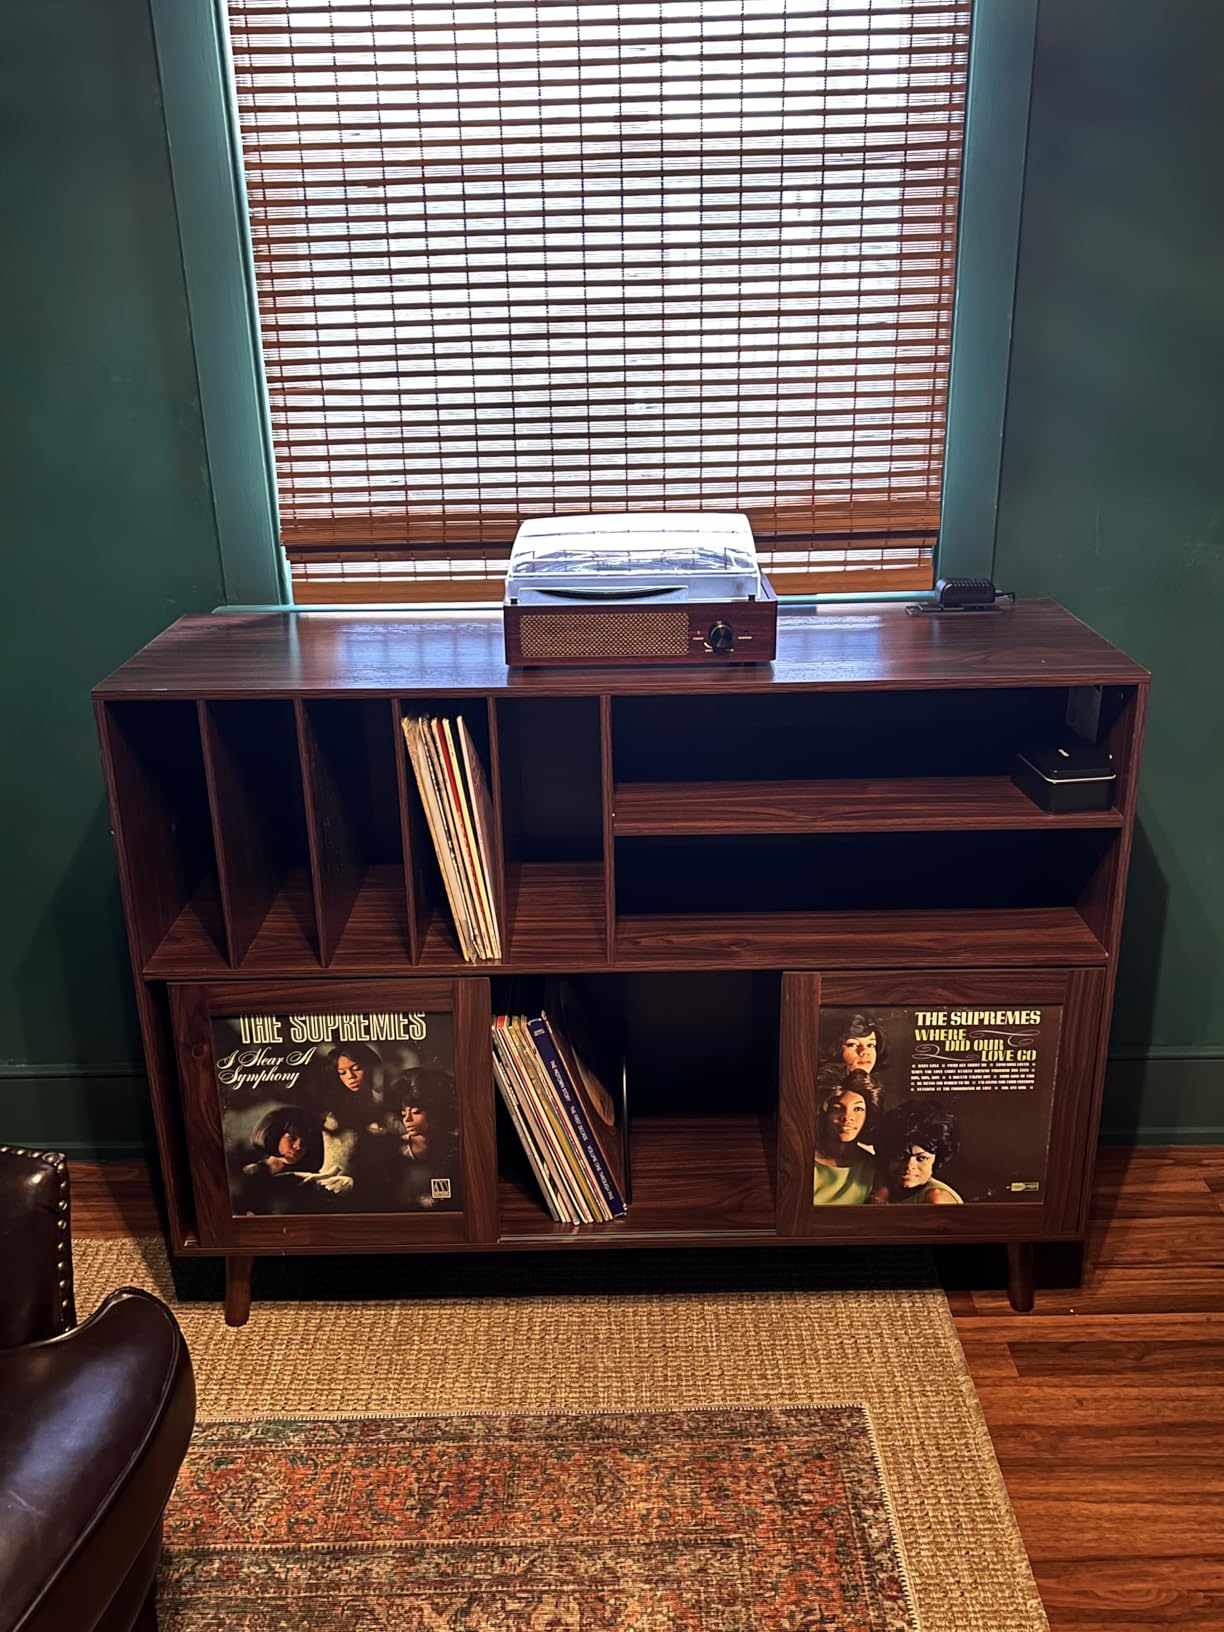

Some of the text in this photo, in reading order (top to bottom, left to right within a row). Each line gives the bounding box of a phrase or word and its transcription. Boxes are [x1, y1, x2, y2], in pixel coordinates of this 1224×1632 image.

[915, 1010, 1041, 1026] THE SUPREMES
[240, 1011, 427, 1044] THE SUPREMES
[914, 1028, 966, 1041] WHERE
[944, 1039, 1004, 1052] DID OUR
[238, 1046, 286, 1068] Hear
[285, 1046, 318, 1066] A
[981, 1049, 1037, 1062] LOVE GO
[217, 1065, 301, 1091] Symphony
